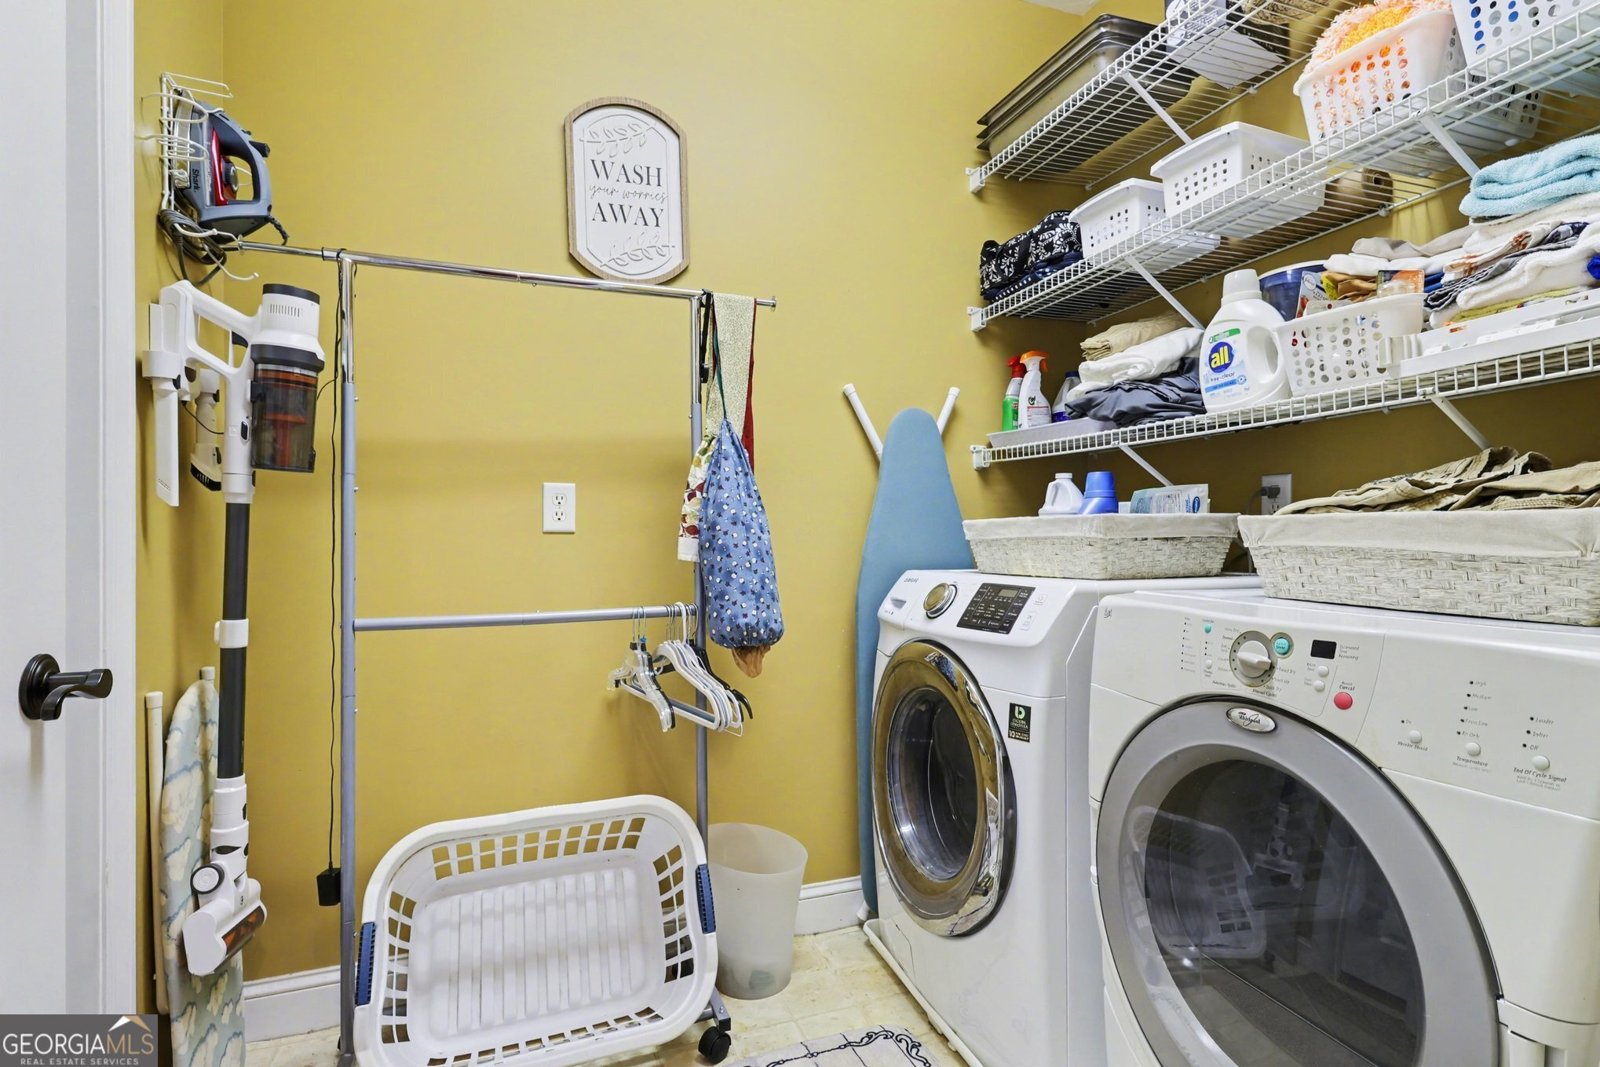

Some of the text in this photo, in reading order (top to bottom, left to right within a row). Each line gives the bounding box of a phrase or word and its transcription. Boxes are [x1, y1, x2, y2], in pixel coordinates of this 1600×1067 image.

[192, 168, 200, 190] Shark
[590, 159, 662, 186] WASH
[589, 184, 619, 200] your
[592, 202, 664, 228] AWAY
[1211, 345, 1229, 368] all
